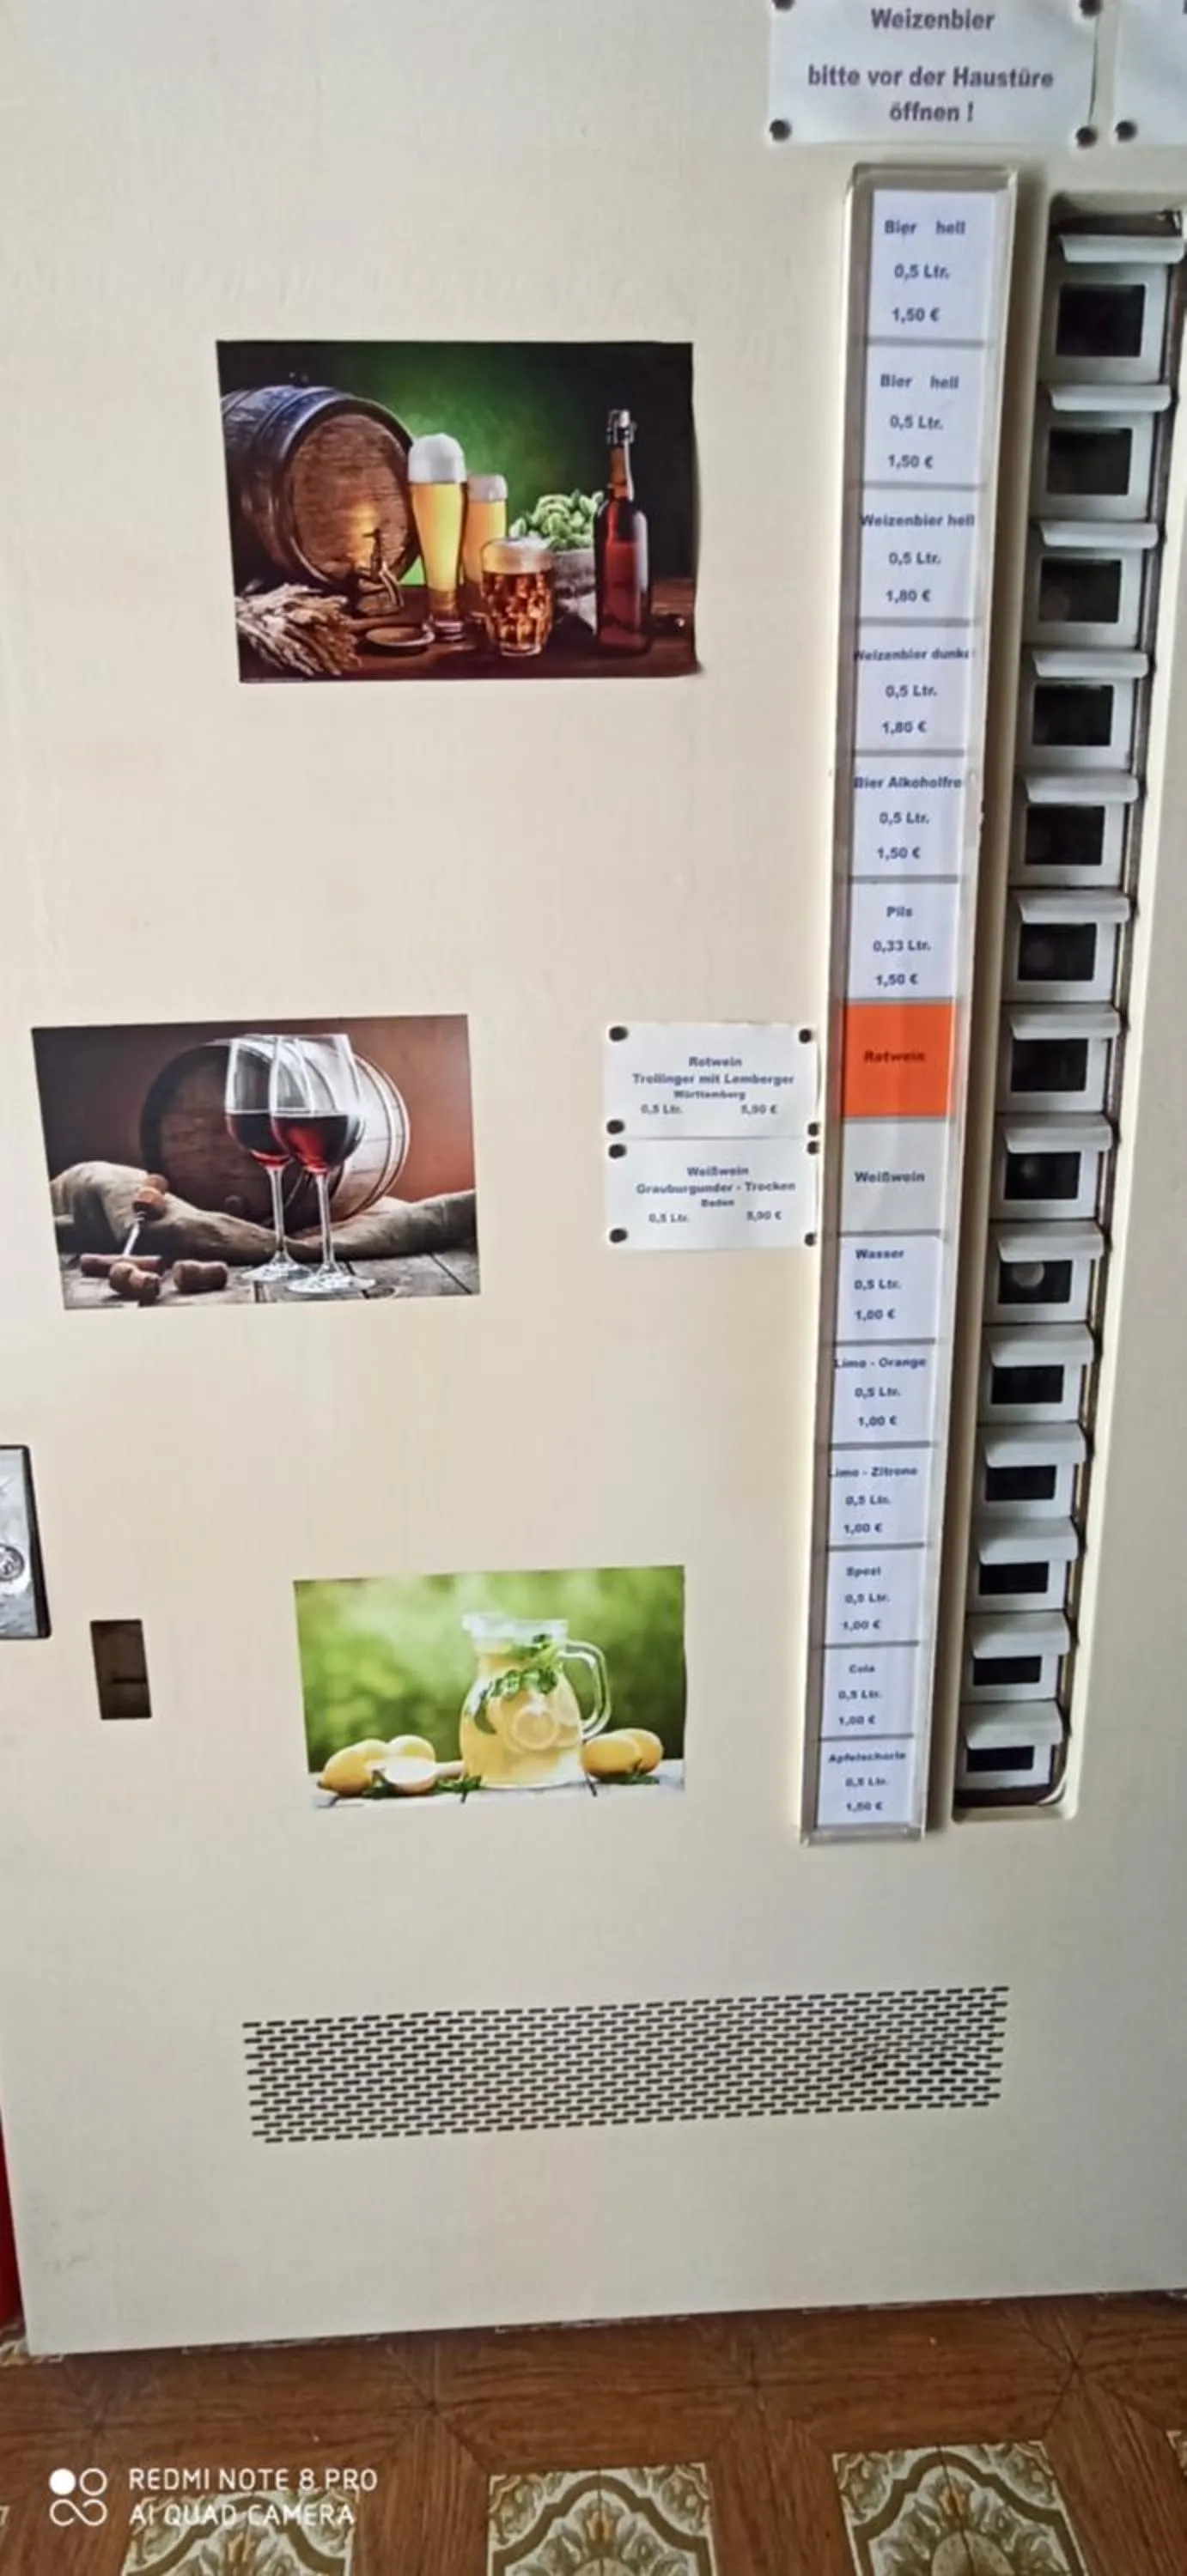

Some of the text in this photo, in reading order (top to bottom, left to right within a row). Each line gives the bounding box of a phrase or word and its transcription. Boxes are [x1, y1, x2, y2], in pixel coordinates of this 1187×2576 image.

[870, 8, 995, 31] Weizenbier
[807, 64, 1055, 89] bitte vor der Haustüre
[889, 101, 975, 122] öffnen !
[884, 219, 965, 236] Bier hell
[893, 264, 951, 281] 0,5 Ltr.
[892, 307, 940, 324] 1,50 €
[880, 374, 959, 390] Bier hell
[890, 415, 943, 431] 0,5 Ltr.
[887, 455, 934, 470] 1,50 €
[861, 514, 975, 528] Weizenbier hell
[888, 551, 941, 566] 0,5 Ltr.
[886, 589, 931, 604] 1,80 €
[885, 685, 937, 700] 0,5 Ltr.
[882, 720, 928, 735] 1,80 €
[854, 775, 962, 789] Bier Alkoholfre
[879, 811, 930, 826] 0,5 Ltr.
[877, 847, 922, 862] 1,50 €
[886, 905, 913, 919] Pils
[873, 940, 932, 954] 0,33 Ltr.
[875, 973, 919, 987] 1,50 €
[688, 1056, 742, 1067] Rotwein
[863, 1050, 925, 1065] Rotwein
[632, 1073, 794, 1086] Trollinger mit Lemberger
[673, 1090, 746, 1101] Württemberg
[662, 1104, 684, 1115] Ltr.
[770, 1103, 779, 1115] €
[686, 1166, 750, 1176] Weißwein
[854, 1170, 925, 1183] Weißwein
[636, 1182, 734, 1196] Grauburgunder
[745, 1182, 796, 1192] Trocken
[701, 1198, 734, 1208] Baden
[774, 1210, 782, 1220] €
[855, 1249, 904, 1260] Wasser
[854, 1279, 902, 1291] 0,5 Ltr.
[855, 1309, 896, 1322] 1,00 €
[833, 1357, 867, 1369] Limo
[879, 1357, 926, 1370] Orange
[854, 1387, 902, 1400] 0,5 Ltr.
[858, 1416, 898, 1429] 1,00 €
[871, 1467, 918, 1478] Zitrone
[845, 1495, 891, 1507] 0,5 Ltr.
[843, 1522, 883, 1535] 1,00 €
[846, 1566, 881, 1578] Spezi
[844, 1594, 891, 1606] 0,5 Ltr.
[843, 1619, 881, 1632] 1,00 €
[849, 1664, 876, 1674] Cola
[838, 1690, 883, 1702] 0,5 Ltr.
[838, 1715, 877, 1727] 1,00 €
[827, 1750, 906, 1765] Apfelschorle
[845, 1777, 865, 1789] 0,5
[875, 1801, 883, 1811] €
